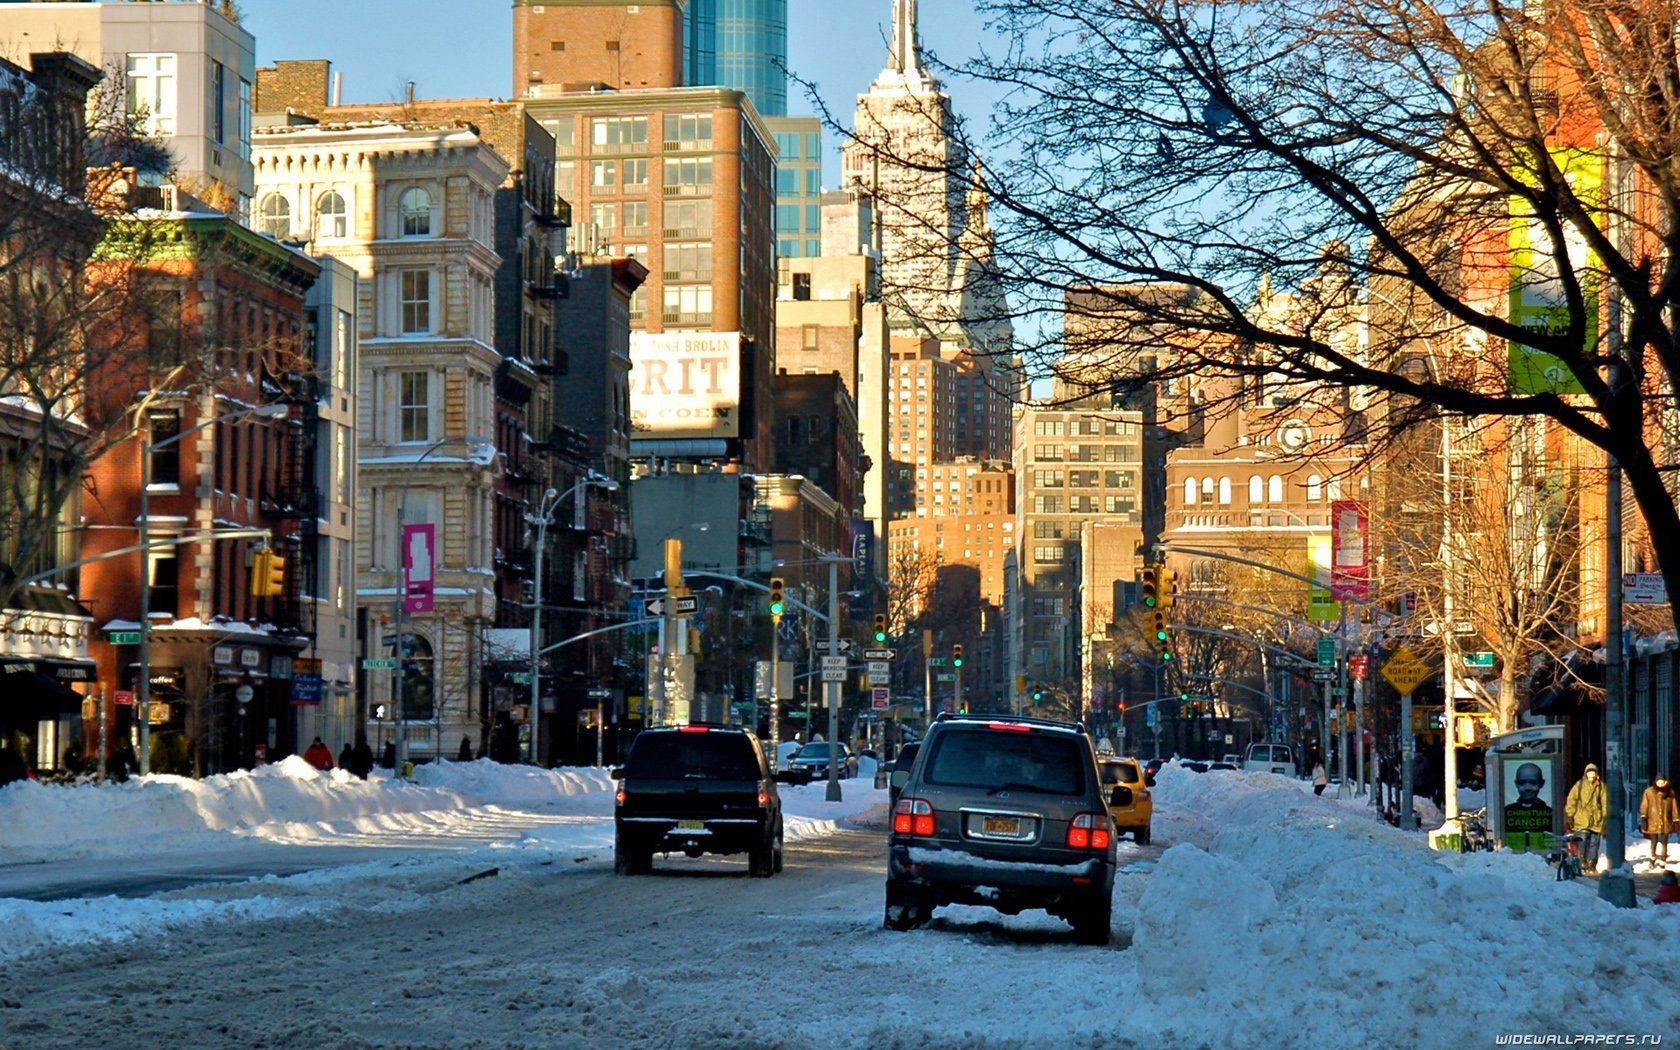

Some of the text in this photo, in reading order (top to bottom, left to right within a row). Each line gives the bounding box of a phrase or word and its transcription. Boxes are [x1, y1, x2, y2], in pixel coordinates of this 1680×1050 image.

[685, 339, 731, 352] BROLIN
[629, 357, 728, 396] RIT
[658, 407, 731, 418] COEN
[858, 534, 867, 574] KAPLAN
[1624, 575, 1636, 585] NO
[1507, 818, 1549, 826] CANCER
